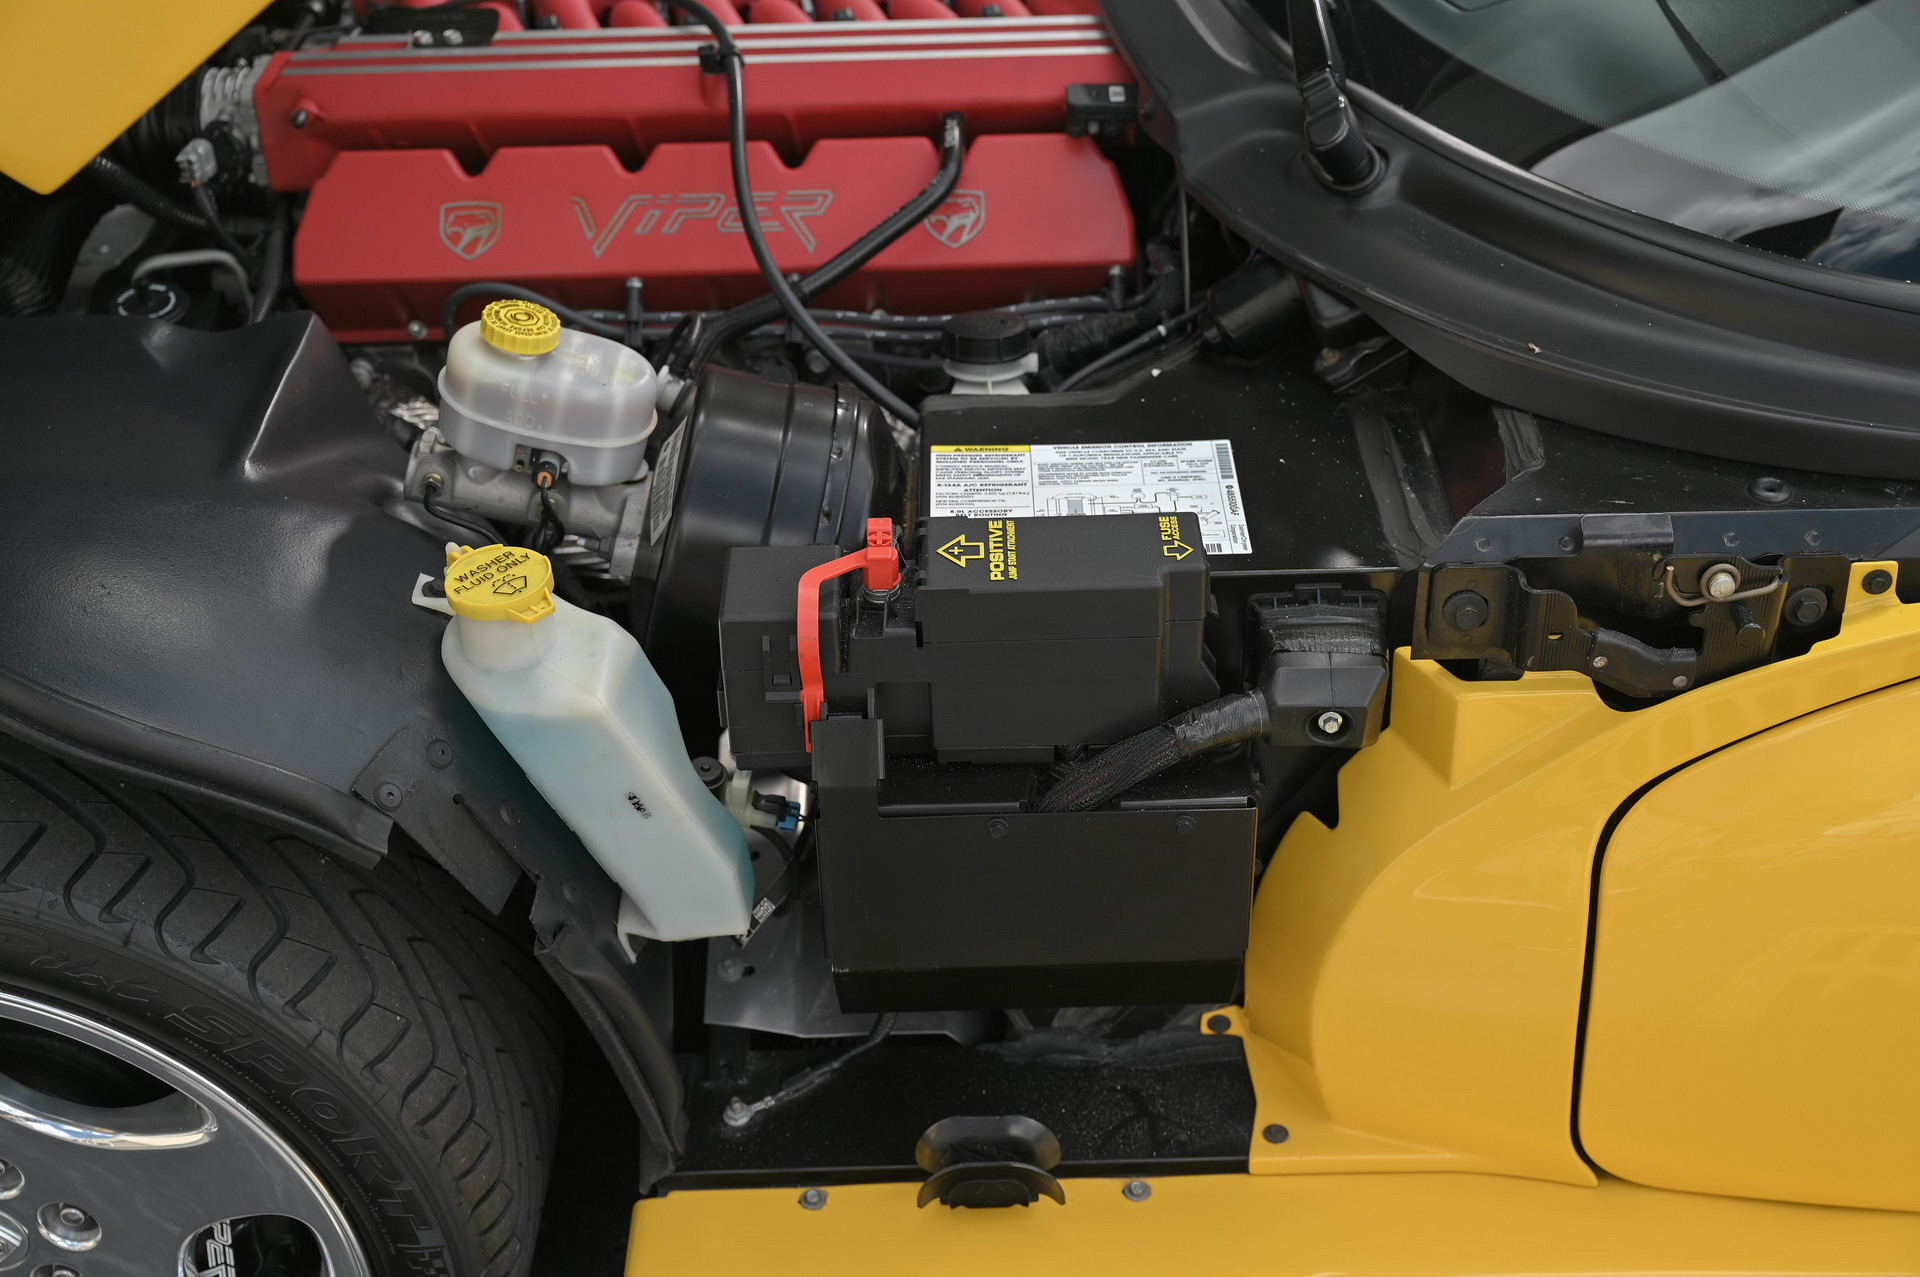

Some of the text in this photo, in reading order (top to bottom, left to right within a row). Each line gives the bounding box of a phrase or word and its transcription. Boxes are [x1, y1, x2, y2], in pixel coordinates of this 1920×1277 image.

[503, 409, 536, 429] ADD
[1158, 516, 1173, 541] FUSE
[1169, 516, 1182, 540] ACCESS
[454, 551, 516, 583] WASHER
[988, 520, 1005, 581] POSITIVE
[1006, 520, 1018, 580] JUMP START ATTACHMENT
[453, 552, 532, 595] FLUID ONLY
[164, 1004, 432, 1231] SPORT
